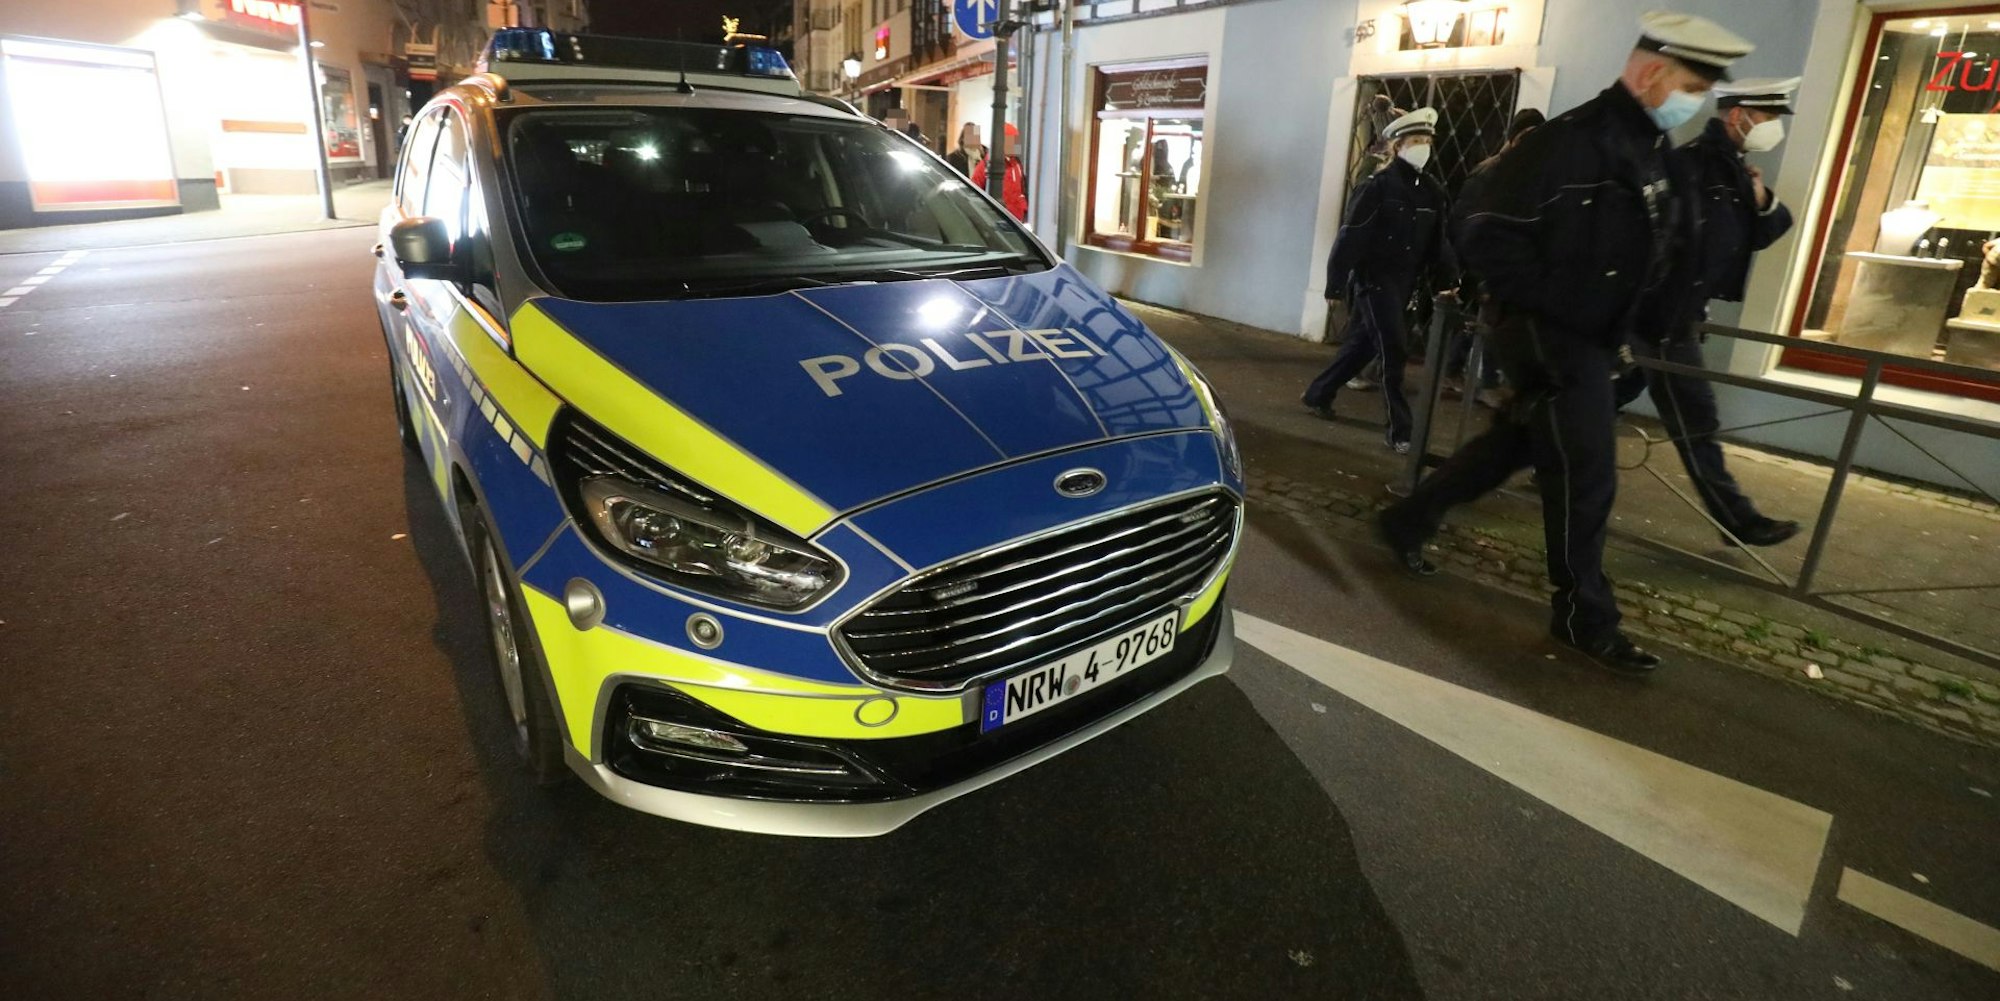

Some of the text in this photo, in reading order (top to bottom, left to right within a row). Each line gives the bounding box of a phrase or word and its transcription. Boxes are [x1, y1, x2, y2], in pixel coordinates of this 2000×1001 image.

[1925, 51, 2000, 92] Zu
[799, 328, 1108, 397] POLIZEI
[1007, 618, 1174, 717] NRW 4-9768
[990, 710, 998, 721] D
